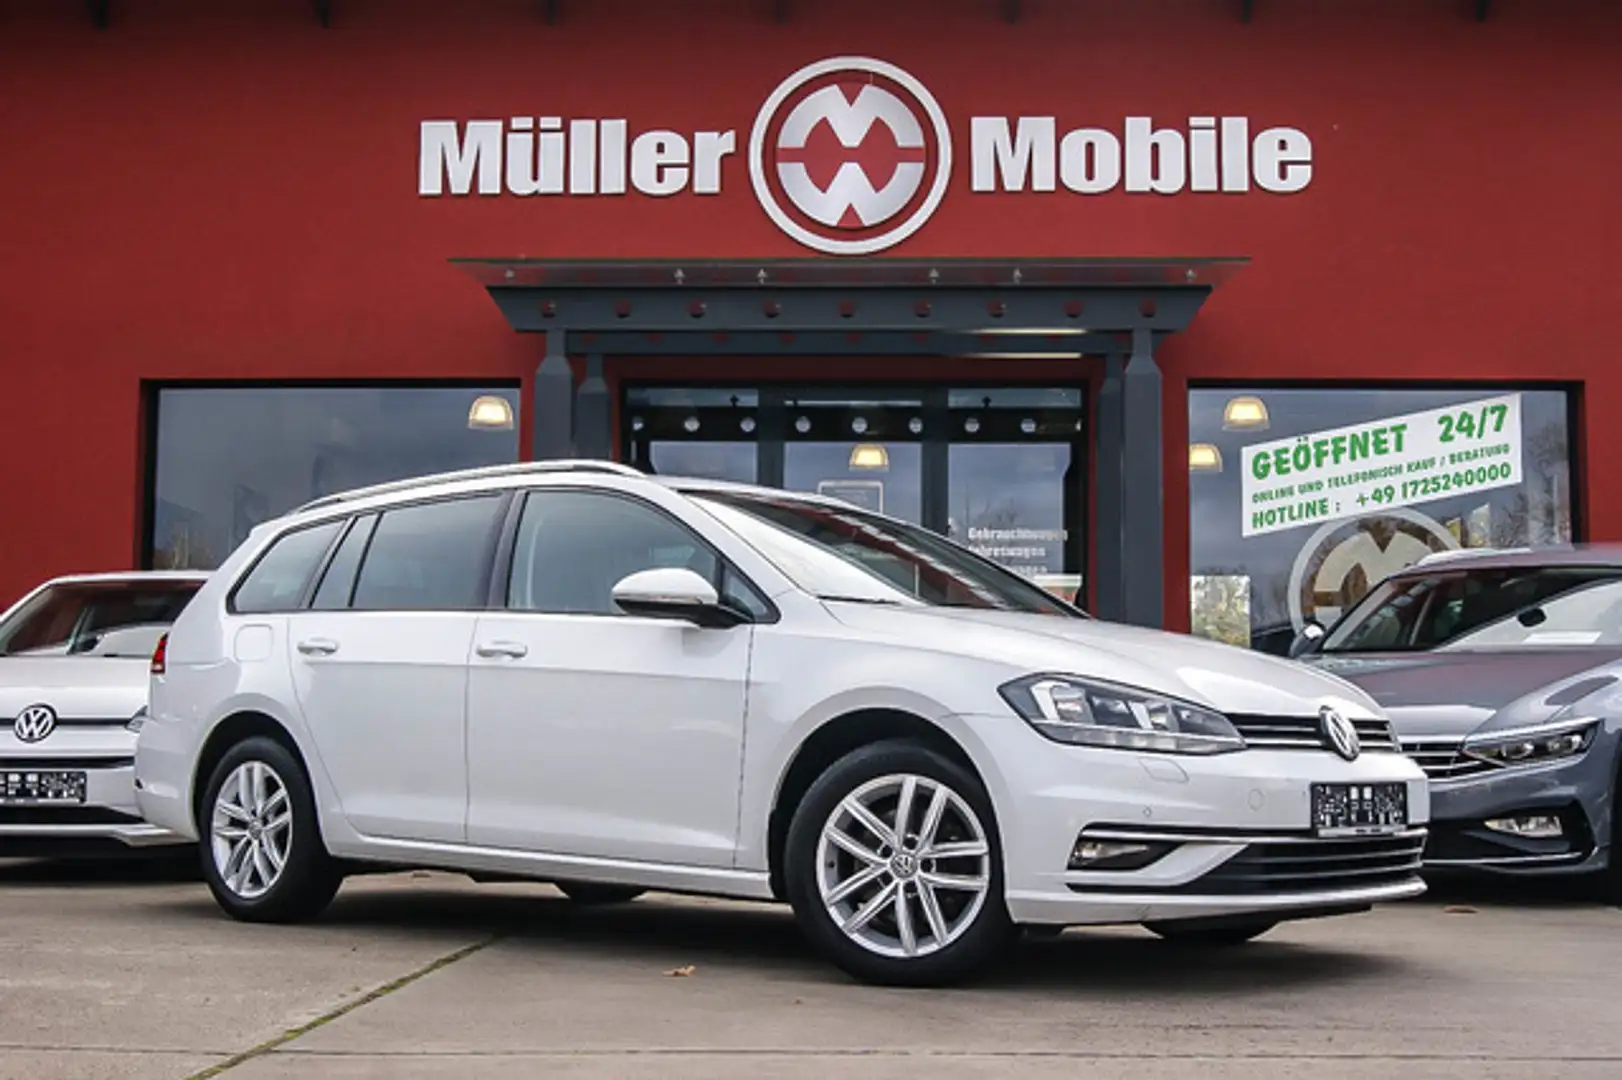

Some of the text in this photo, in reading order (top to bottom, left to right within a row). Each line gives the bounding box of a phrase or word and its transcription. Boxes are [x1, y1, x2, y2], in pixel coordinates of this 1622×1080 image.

[418, 115, 1313, 196] Müller Mobile
[1252, 404, 1508, 480] GEÖFFNET 24/7
[1252, 484, 1294, 503] ONLINE
[1298, 480, 1324, 495] UND
[1328, 464, 1402, 489] TELEFONISCH
[1407, 457, 1436, 473] KAUF
[1449, 443, 1510, 465] BERATUNG
[1356, 485, 1395, 507] +49
[1401, 462, 1512, 499] 1725240000
